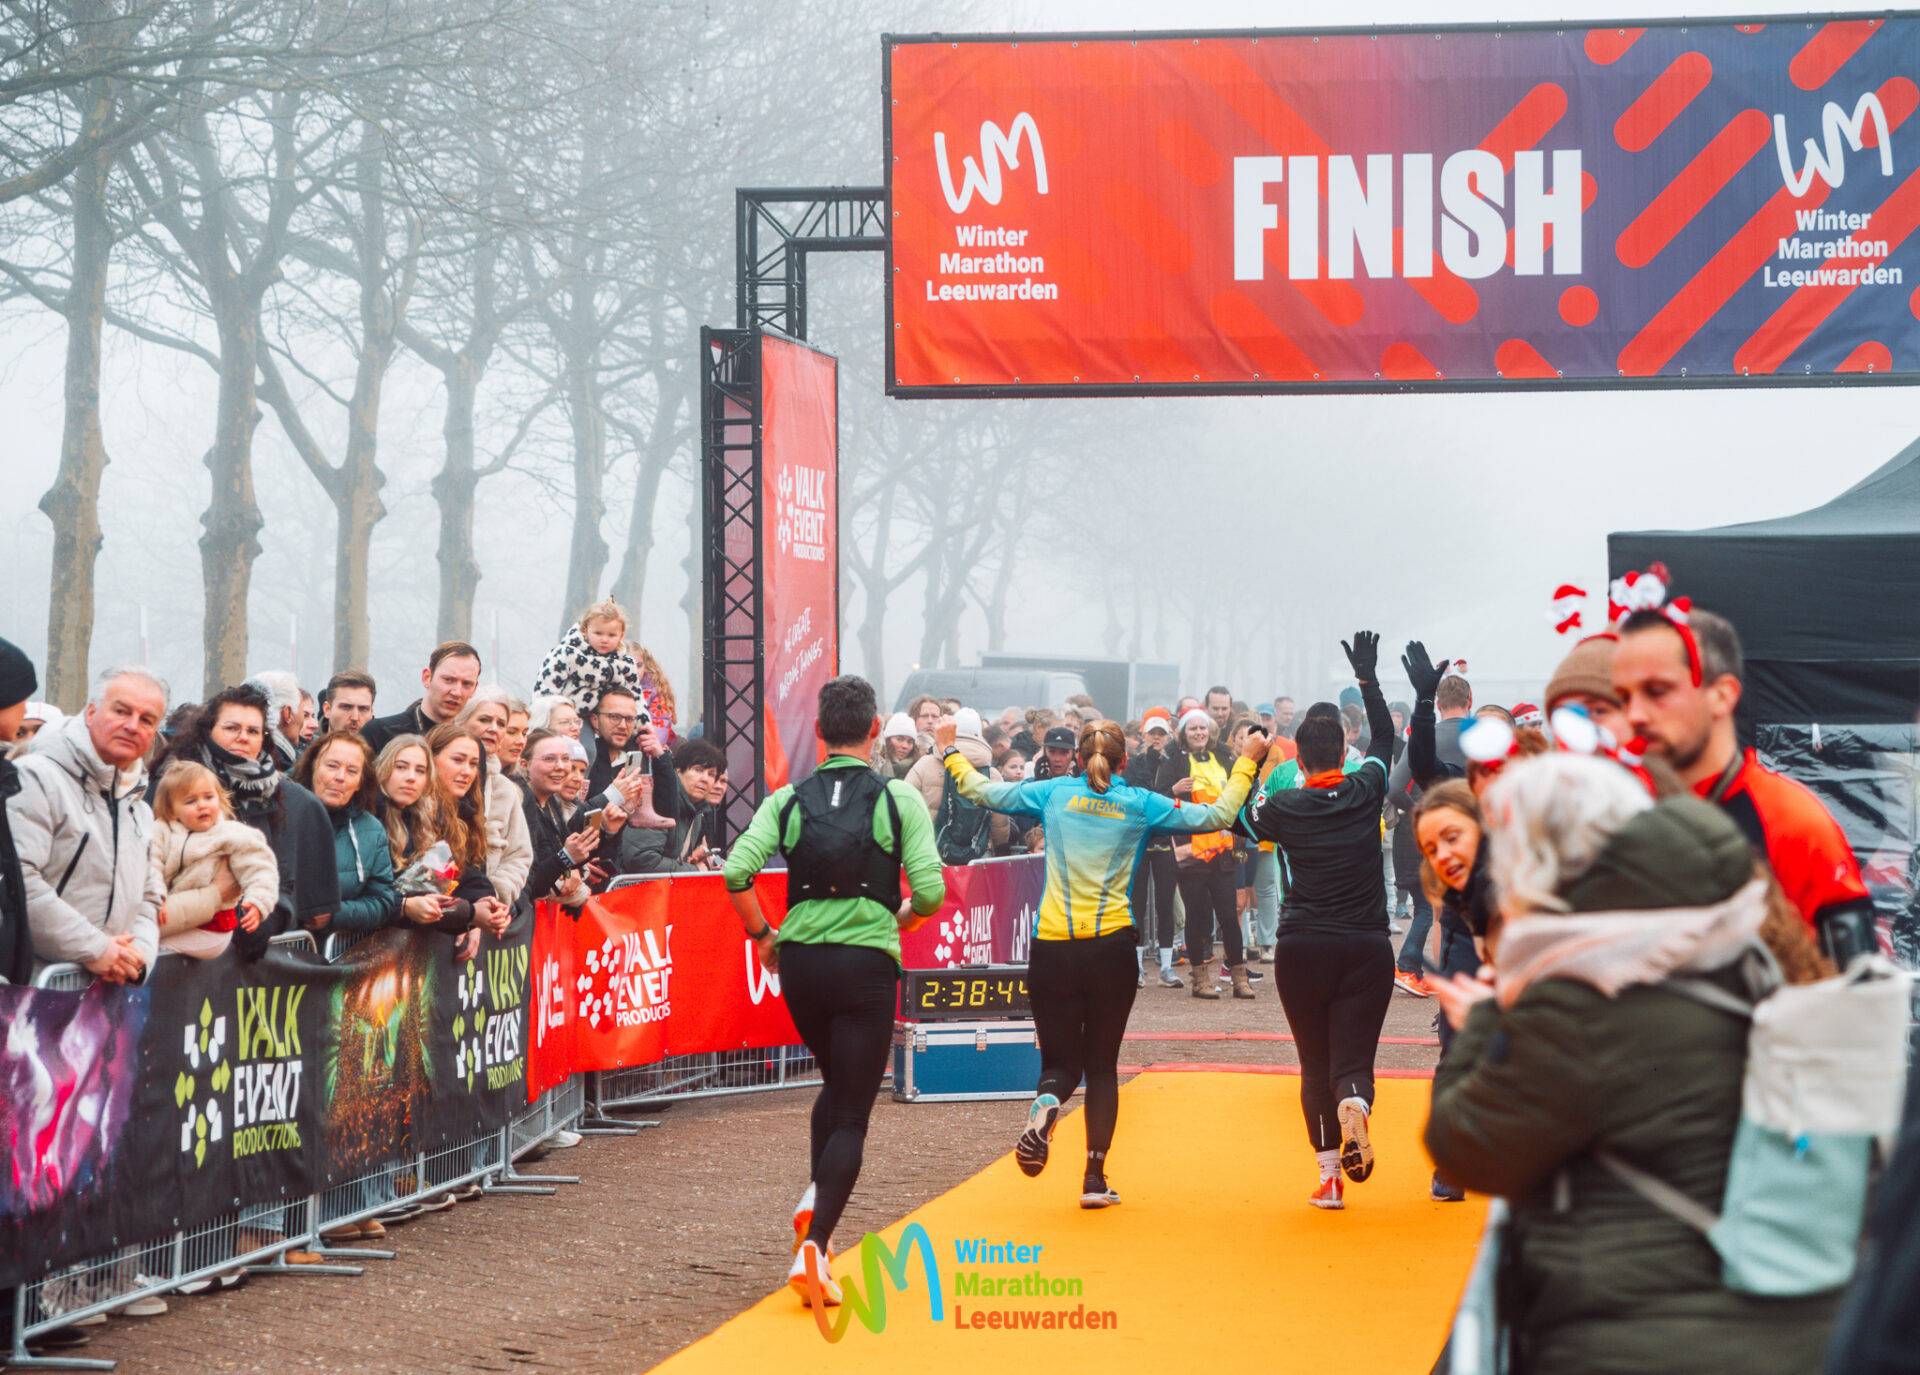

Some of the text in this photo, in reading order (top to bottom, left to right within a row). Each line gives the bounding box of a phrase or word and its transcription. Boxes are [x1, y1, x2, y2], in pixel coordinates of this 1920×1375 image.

[1234, 149, 1582, 280] FINISH
[1795, 209, 1871, 231] Winter
[956, 225, 1028, 247] Winter
[1778, 236, 1888, 259] Marathon
[939, 252, 1044, 274] Marathon
[1764, 263, 1902, 287] Leeuwarden
[926, 278, 1058, 301] Leeuwarden
[795, 465, 826, 510] VALK
[794, 508, 825, 544] EVENT
[970, 905, 993, 943] VALK
[236, 985, 307, 1060] VALK
[234, 1060, 302, 1127] EVENT
